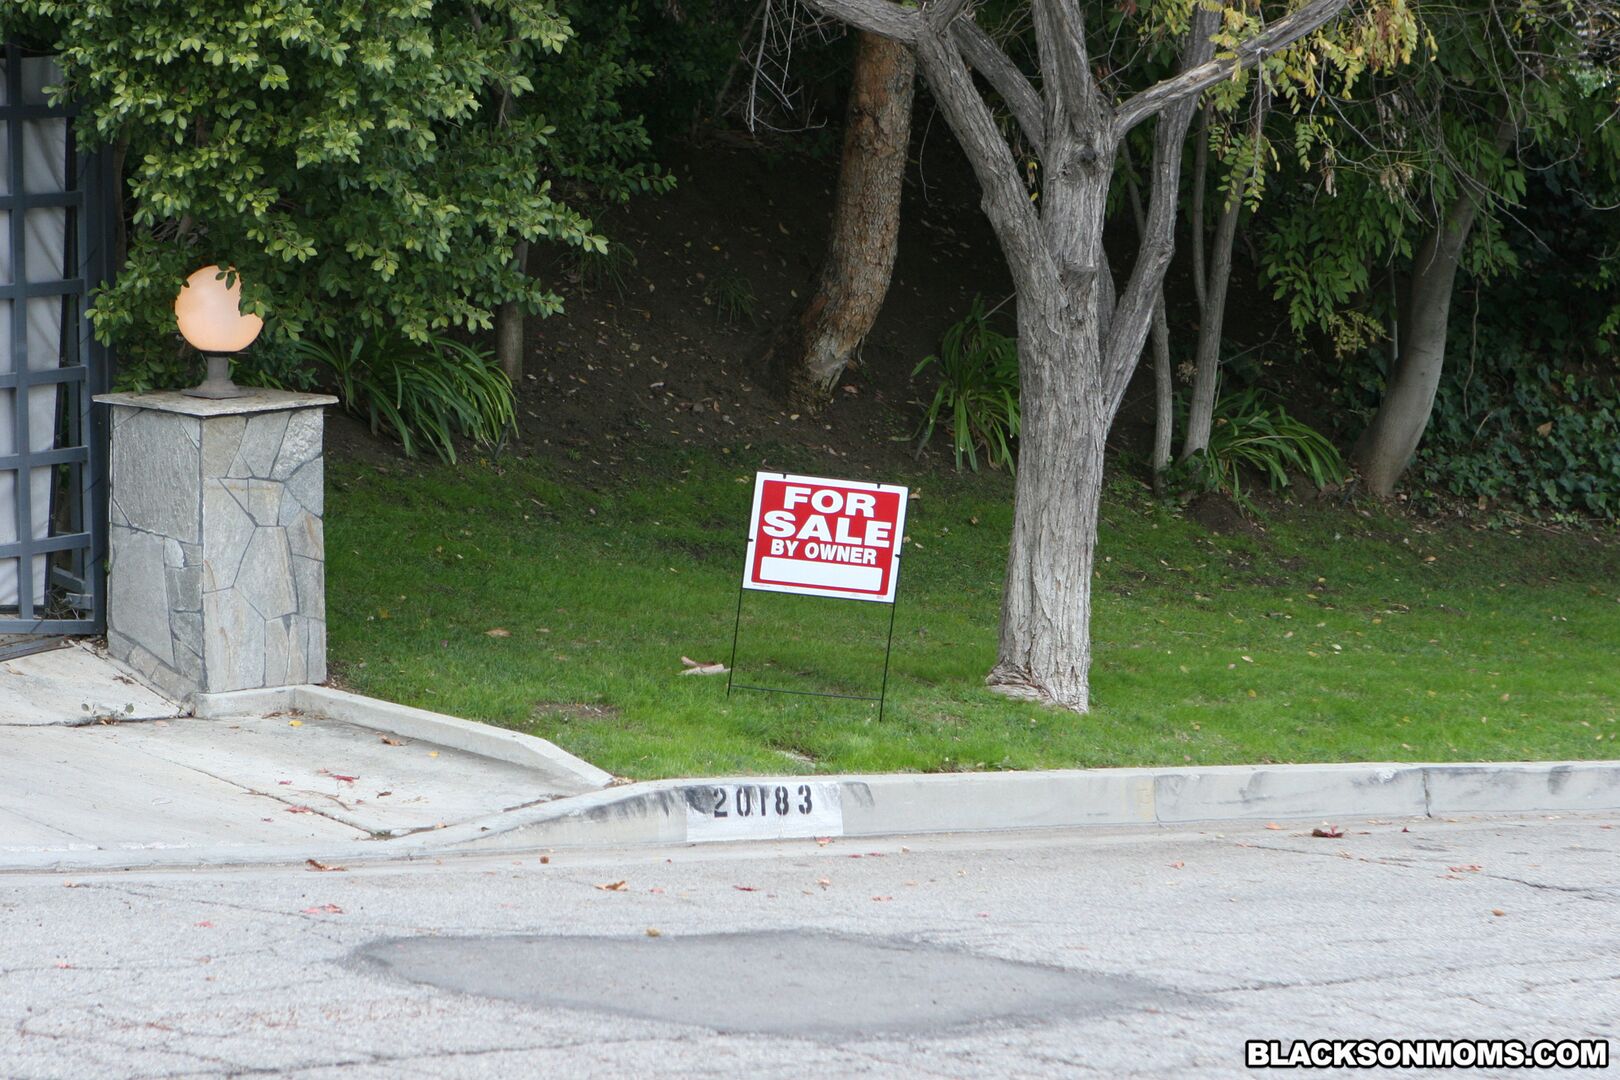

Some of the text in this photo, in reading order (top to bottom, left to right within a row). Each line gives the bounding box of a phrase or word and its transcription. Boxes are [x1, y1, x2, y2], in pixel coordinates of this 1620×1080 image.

[783, 485, 877, 518] FOR
[762, 510, 892, 548] SALE
[770, 539, 877, 565] BY OWNER
[713, 784, 813, 818] 20183
